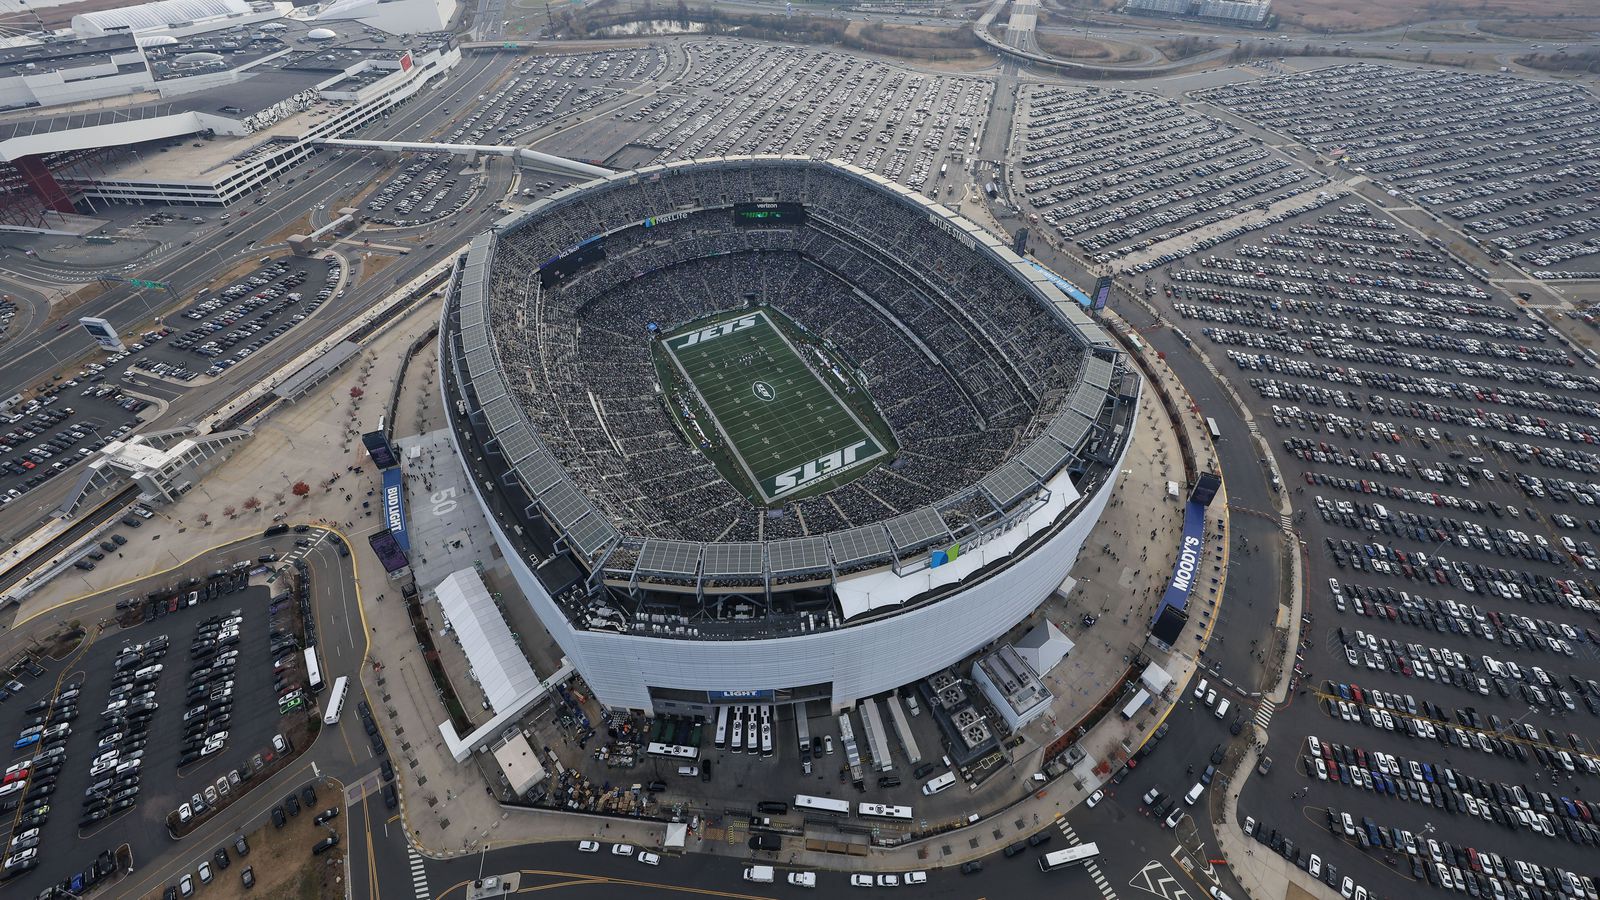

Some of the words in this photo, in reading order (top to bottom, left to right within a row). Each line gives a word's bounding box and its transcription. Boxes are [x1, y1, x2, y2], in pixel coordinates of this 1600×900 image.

[655, 211, 688, 225] MetLife
[929, 213, 952, 235] METLIFE
[952, 228, 976, 251] STADIUM
[677, 315, 756, 350] JETS
[774, 440, 866, 495] JETS
[387, 486, 399, 506] BUD
[430, 486, 458, 516] 50
[389, 505, 402, 531] LIGHT
[1172, 535, 1200, 592] MOODY'S
